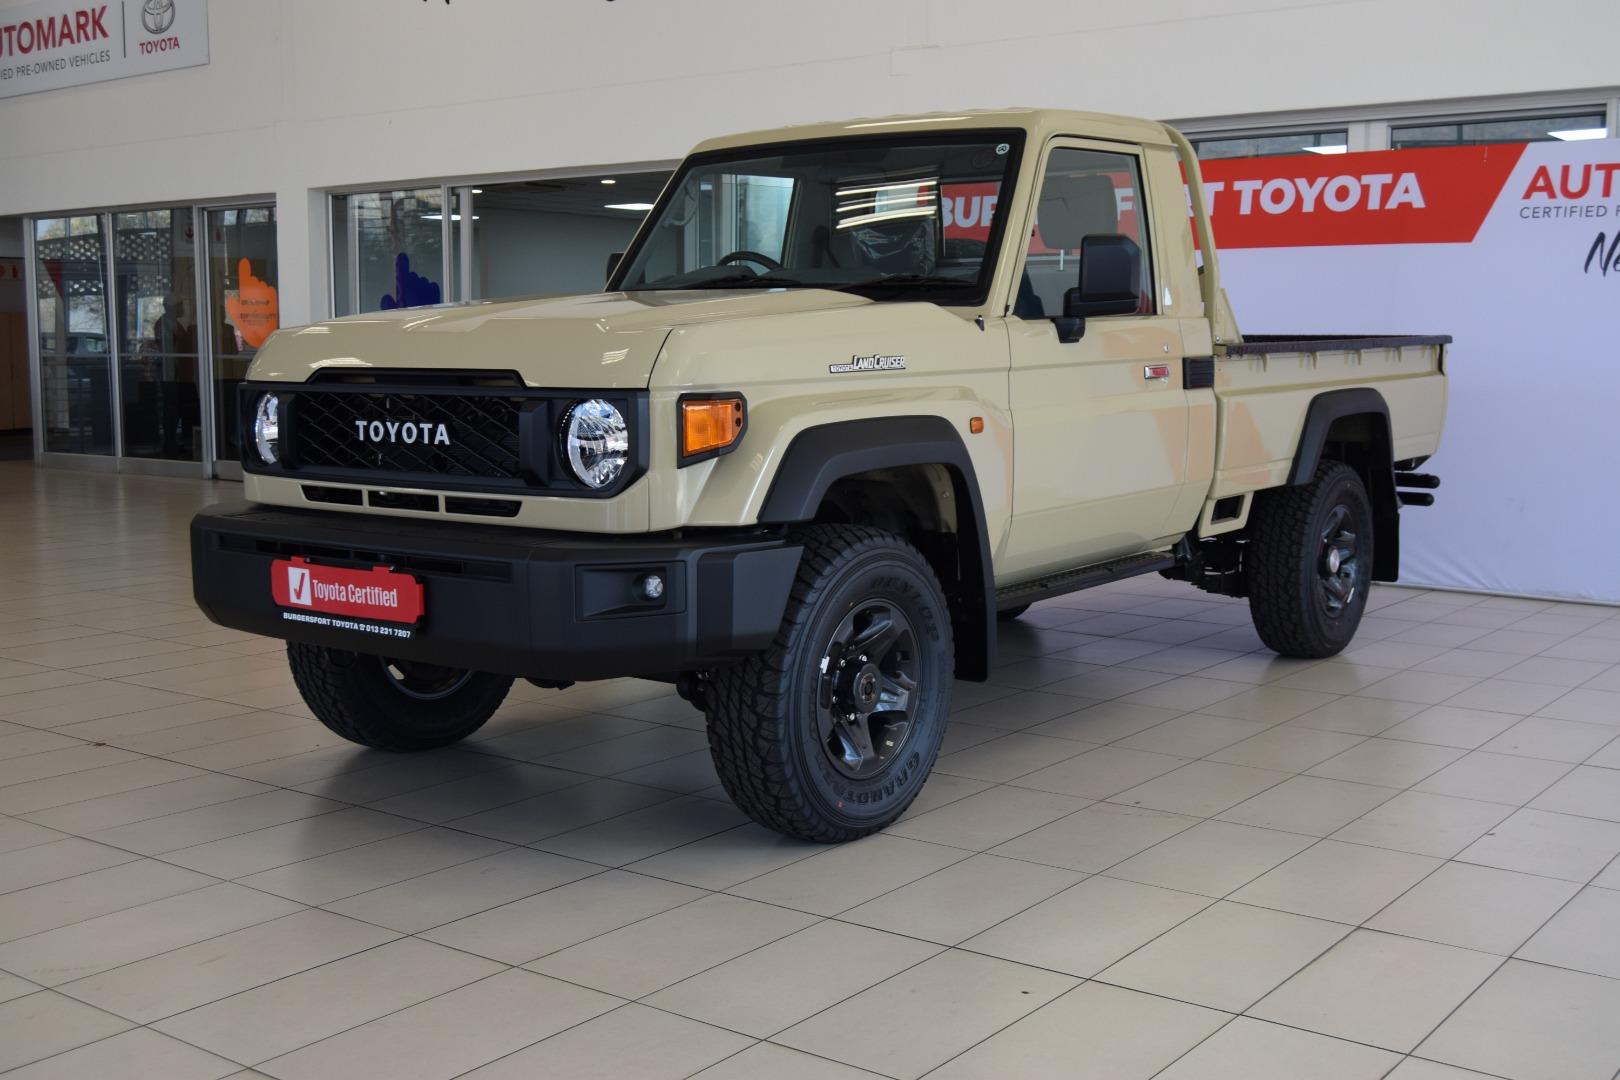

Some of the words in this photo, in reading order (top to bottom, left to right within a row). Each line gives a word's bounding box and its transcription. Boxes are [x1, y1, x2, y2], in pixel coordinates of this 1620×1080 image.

[0, 5, 109, 58] TOMARK
[139, 36, 180, 56] TOYOTA
[16, 58, 67, 78] PRE-OWNED
[69, 50, 111, 72] VEHICLES
[1232, 172, 1426, 216] TOYOTA
[1519, 205, 1608, 220] CERTIFIED
[355, 420, 450, 445] TOYOTA
[312, 579, 347, 602] Toyota
[348, 584, 398, 608] Certified
[283, 612, 331, 626] BURGERSFORT
[332, 619, 358, 631] TOYOTA
[365, 625, 379, 633] 013
[380, 627, 393, 636] 231
[394, 629, 411, 639] 7207
